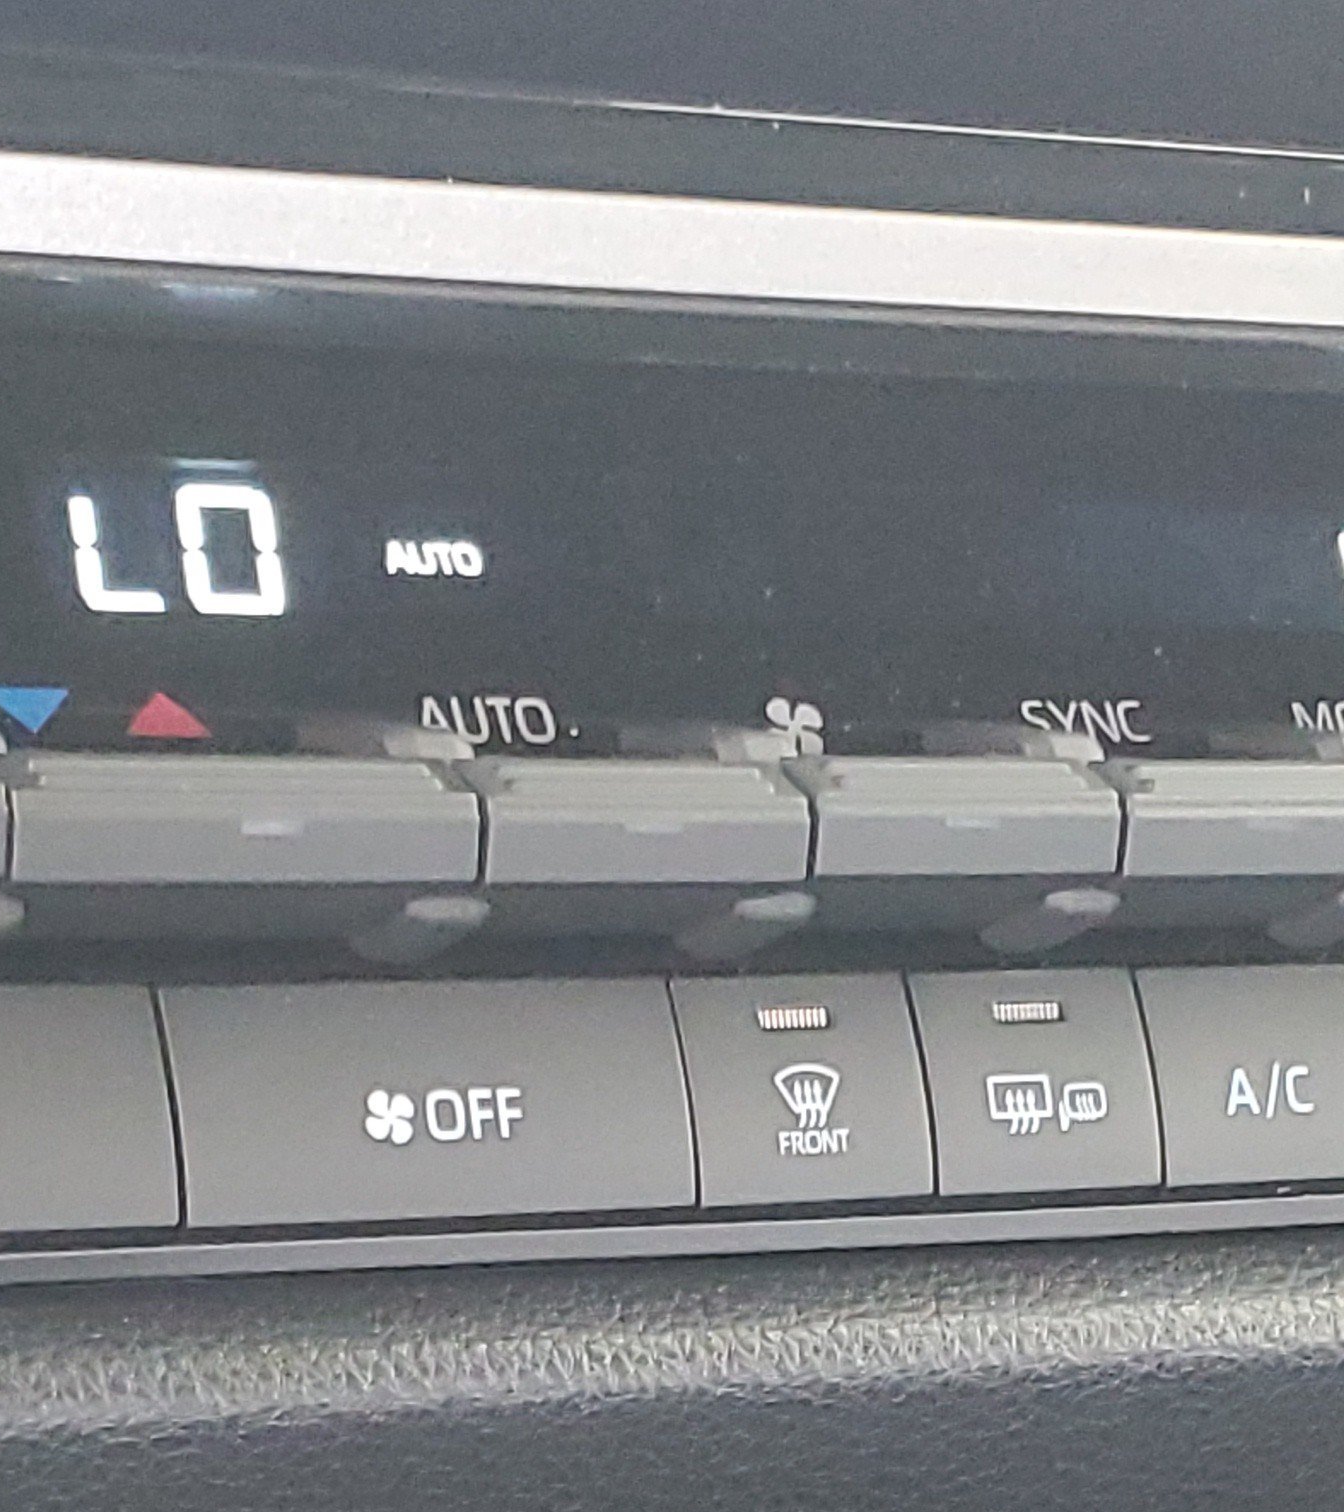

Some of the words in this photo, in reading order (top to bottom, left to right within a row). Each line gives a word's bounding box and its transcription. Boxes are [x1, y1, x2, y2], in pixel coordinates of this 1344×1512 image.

[67, 483, 286, 616] LO
[385, 539, 484, 578] AUTO
[421, 696, 556, 744] AUTO
[1020, 699, 1152, 743] SYNC
[1226, 1061, 1315, 1119] A/C
[424, 1087, 523, 1142] OFF
[778, 1126, 850, 1156] FRONT
